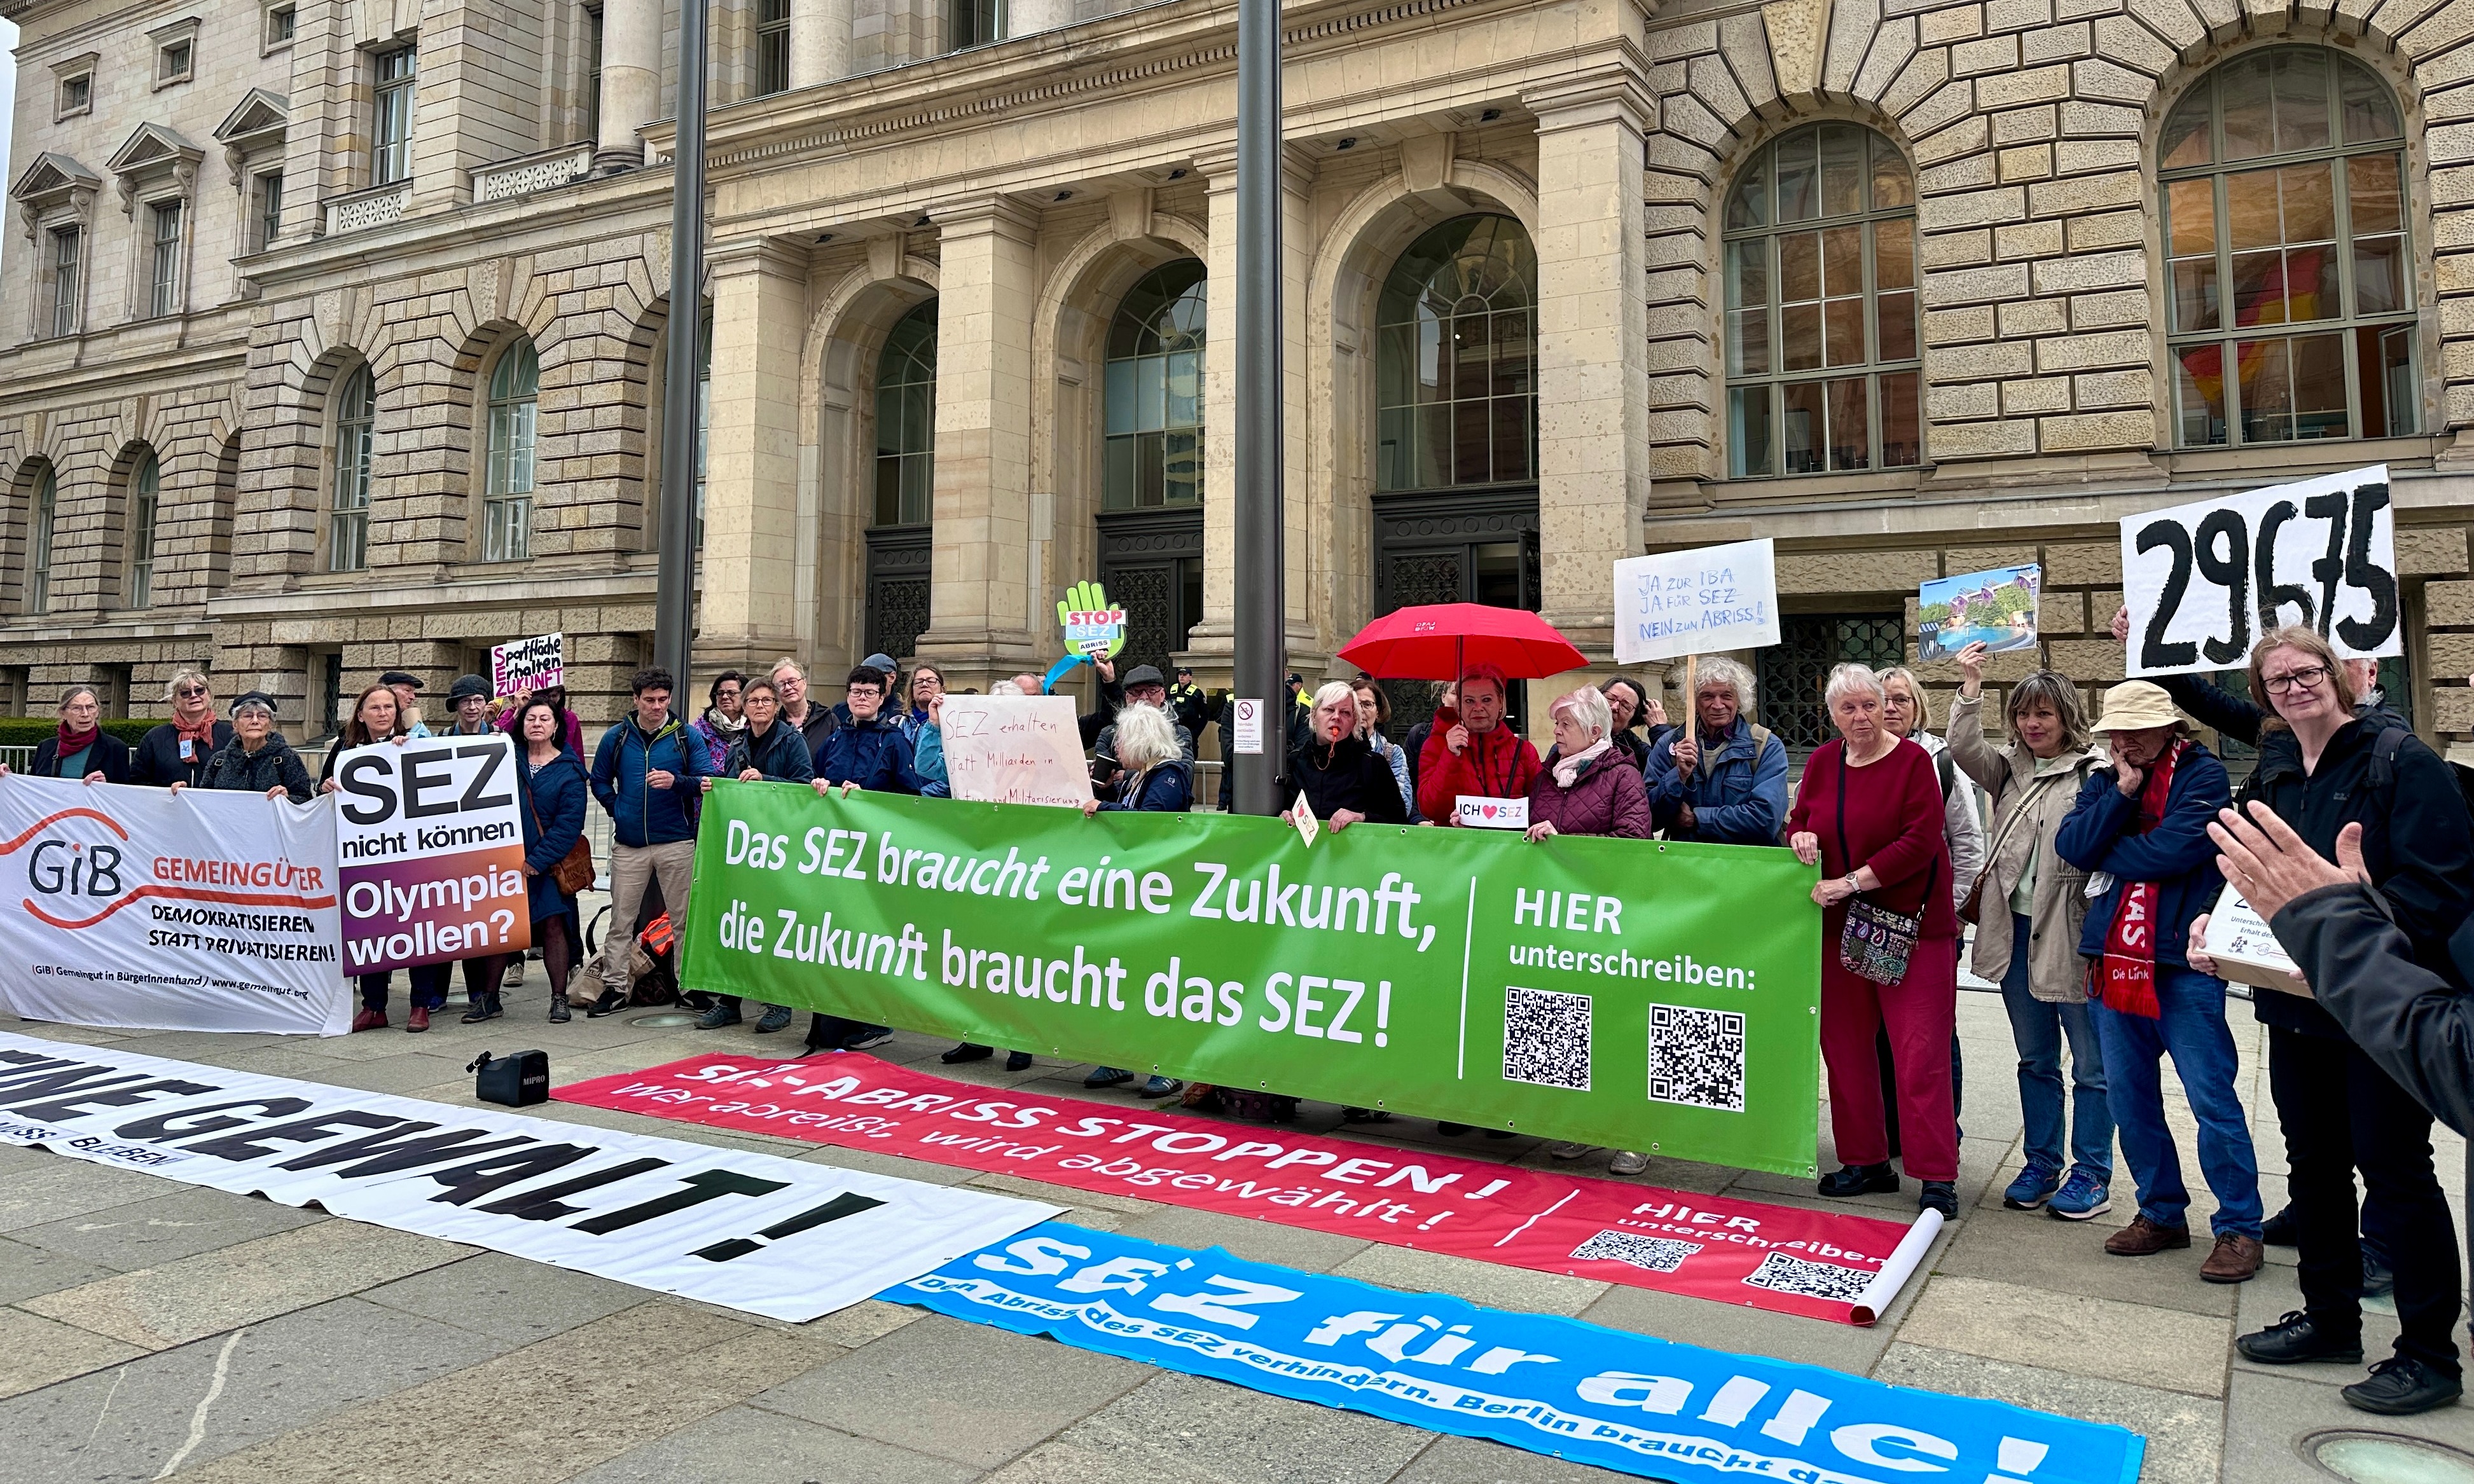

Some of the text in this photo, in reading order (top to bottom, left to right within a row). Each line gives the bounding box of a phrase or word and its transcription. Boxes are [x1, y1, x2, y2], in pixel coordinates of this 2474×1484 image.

[1638, 568, 1735, 596] JA ZUR IBA
[2136, 483, 2398, 669] 29675
[1640, 587, 1743, 614] JA FÜR SEZ
[1070, 610, 1122, 625] STOP
[1076, 626, 1110, 637] SEZ
[1639, 601, 1765, 641] NEIN ZUM ABRISS!
[494, 636, 561, 666] Sportfläche
[1080, 640, 1108, 649] ABRISS
[496, 657, 561, 682] Erhalten
[496, 667, 562, 697] ZUKUNFT
[946, 710, 1056, 739] SEZ erhalten
[950, 752, 977, 774] statt
[987, 752, 1035, 768] Milliarden
[340, 743, 512, 825] SEZ
[1009, 788, 1079, 808] Militarisierung
[1303, 814, 1315, 837] SEZ
[1459, 804, 1521, 818] ICH SEZ
[342, 819, 515, 860] nicht können
[29, 841, 121, 897] GiB
[153, 856, 322, 891] GEMEINGÜTER
[347, 864, 523, 924] Olympia
[726, 820, 1436, 952] Das SEZ braucht eine Zukunft,
[152, 905, 314, 934] DEMOKRATISIEREN
[1514, 888, 1622, 935] HIER
[149, 930, 336, 963] STATT PRIVATISIEREN!
[347, 909, 515, 966] wollen?
[2240, 928, 2260, 936] Erhalt
[720, 900, 763, 953] die
[773, 908, 929, 981] Zukunft
[943, 928, 1127, 1011] braucht
[1145, 956, 1244, 1027] das
[1509, 944, 1756, 990] unterschreiben:
[2113, 968, 2125, 980] Die
[32, 965, 55, 976] (GiB)
[56, 966, 102, 980] Gemeingut
[106, 971, 114, 980] in
[117, 971, 202, 986] BürgerInnenhand
[212, 980, 308, 1000] www.gemeingut.org
[609, 1083, 715, 1105] wer
[709, 1100, 901, 1138] abreißt,
[918, 1129, 1063, 1161] wird
[69, 1136, 177, 1165] BLEIBEN
[1631, 1203, 1761, 1233] HIER
[974, 1237, 1304, 1329] SEZ
[1304, 1310, 1562, 1375] für
[918, 1278, 978, 1292] Den
[981, 1293, 1080, 1317] Abriss
[1085, 1308, 1144, 1333] des
[1152, 1328, 1227, 1353] SEZ
[1231, 1347, 1437, 1402] verhindern.
[1453, 1394, 1579, 1432] Berlin
[1591, 1425, 1774, 1473] braucht
